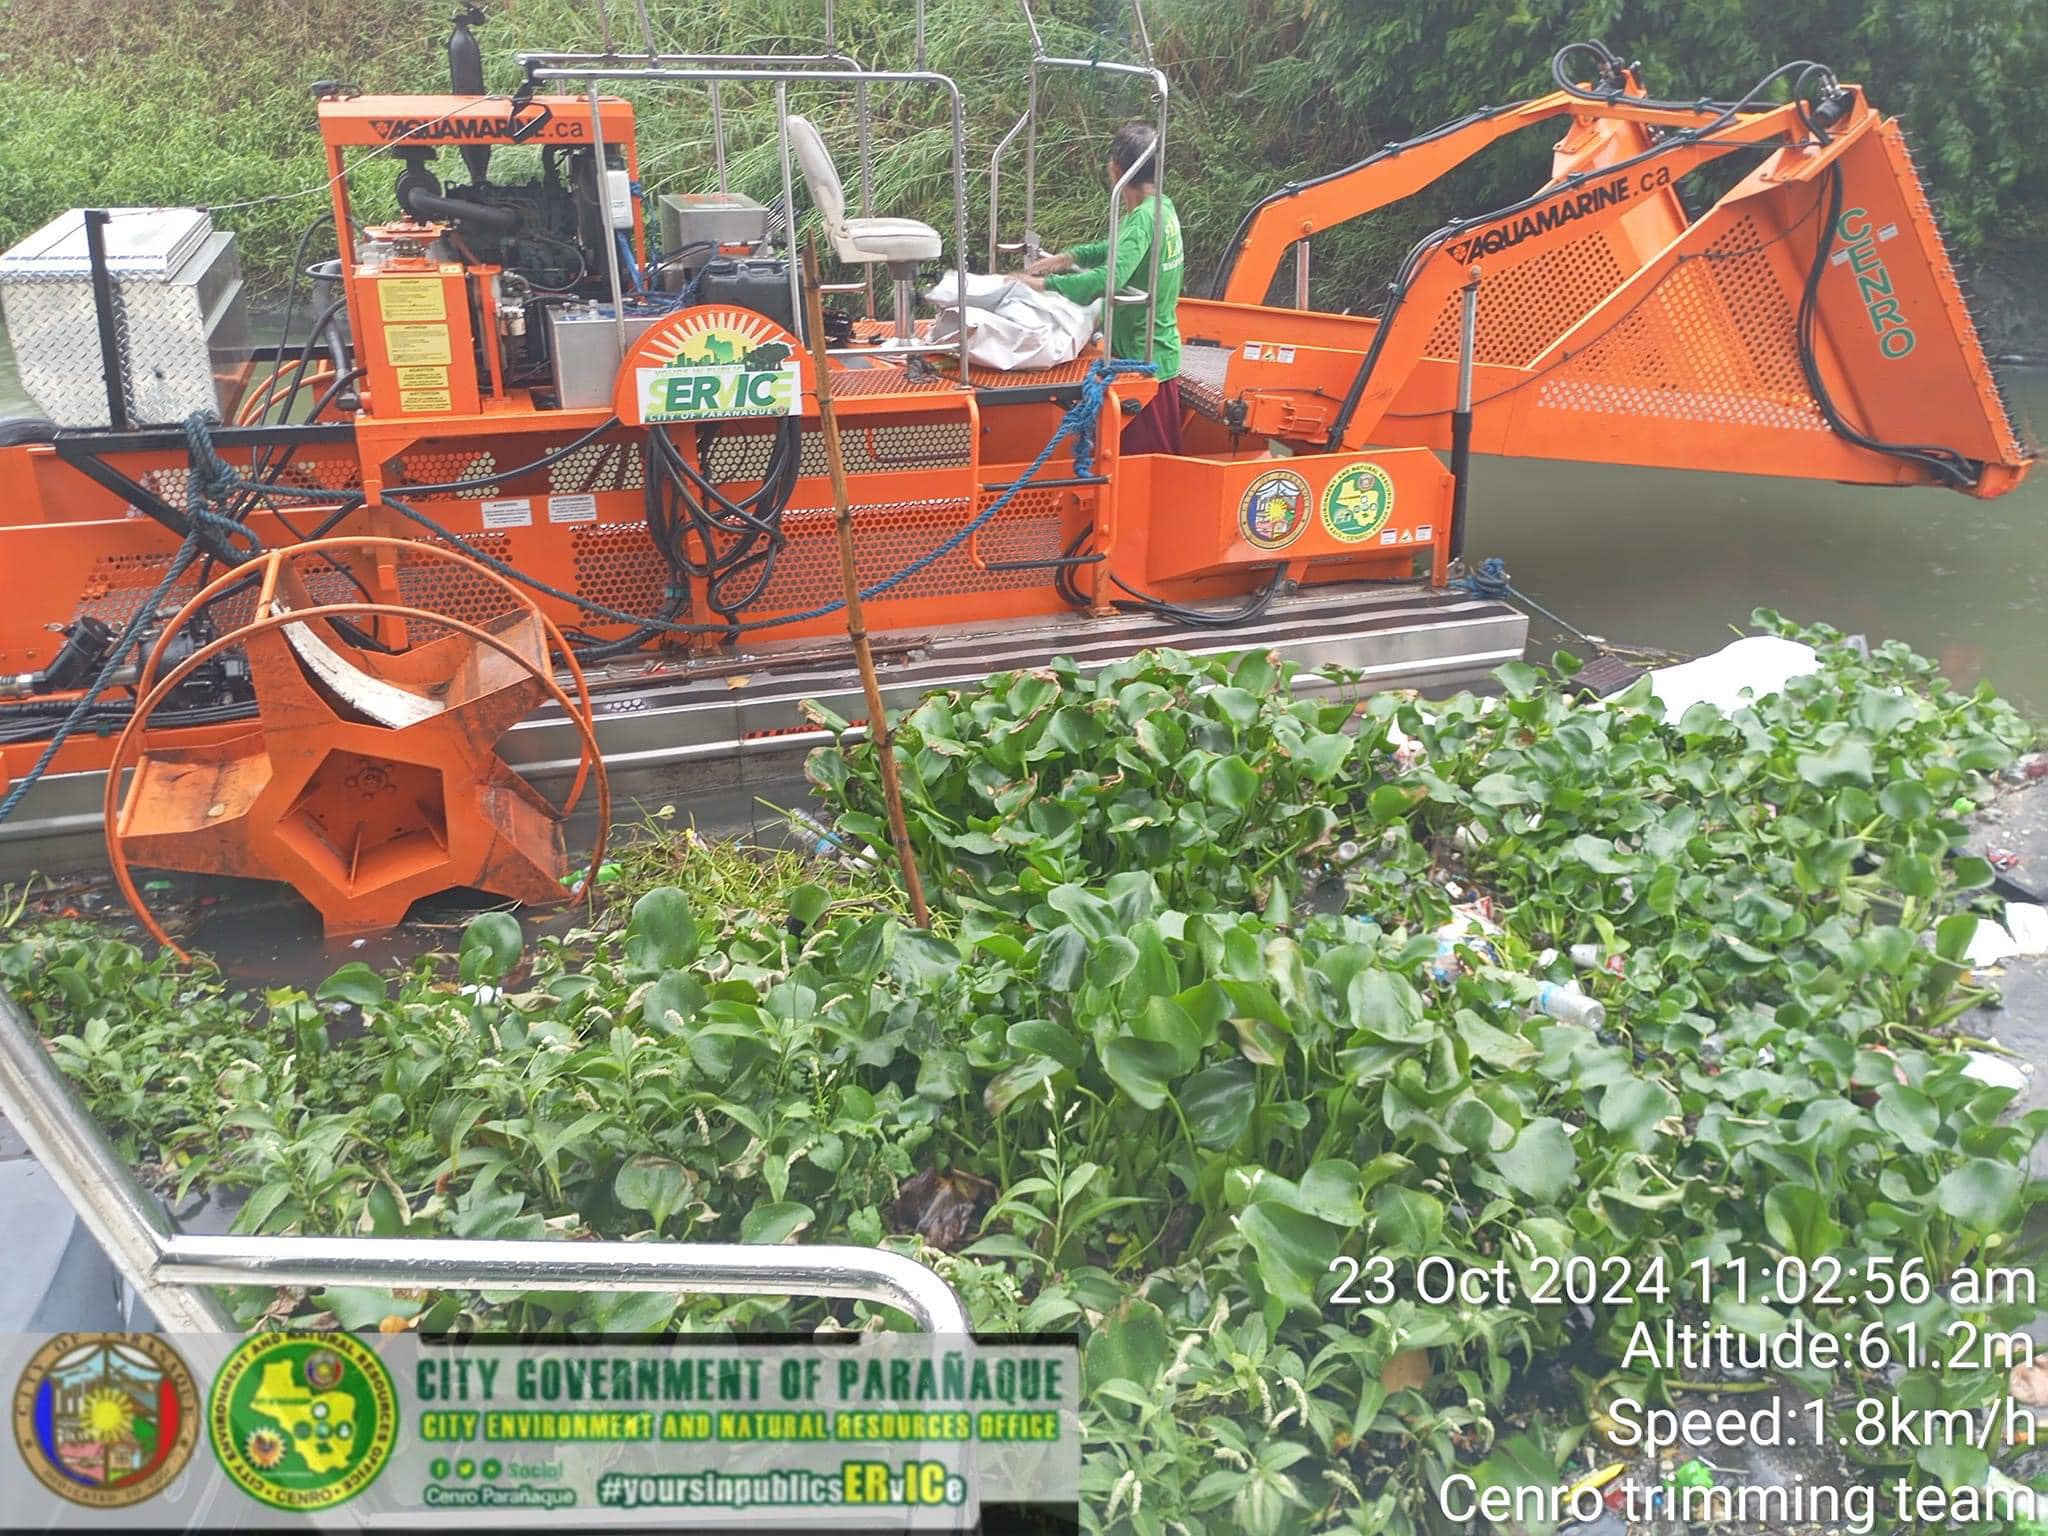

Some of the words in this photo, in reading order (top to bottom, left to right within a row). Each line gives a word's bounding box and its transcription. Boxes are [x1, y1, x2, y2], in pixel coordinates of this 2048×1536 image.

[385, 119, 584, 140] AQUAMARNE.ca
[1465, 166, 1670, 266] AQUAMARINE.ca
[1836, 207, 1916, 360] CENRO
[646, 371, 795, 413] SERVICE
[649, 412, 677, 422] CITY
[680, 411, 697, 420] OF
